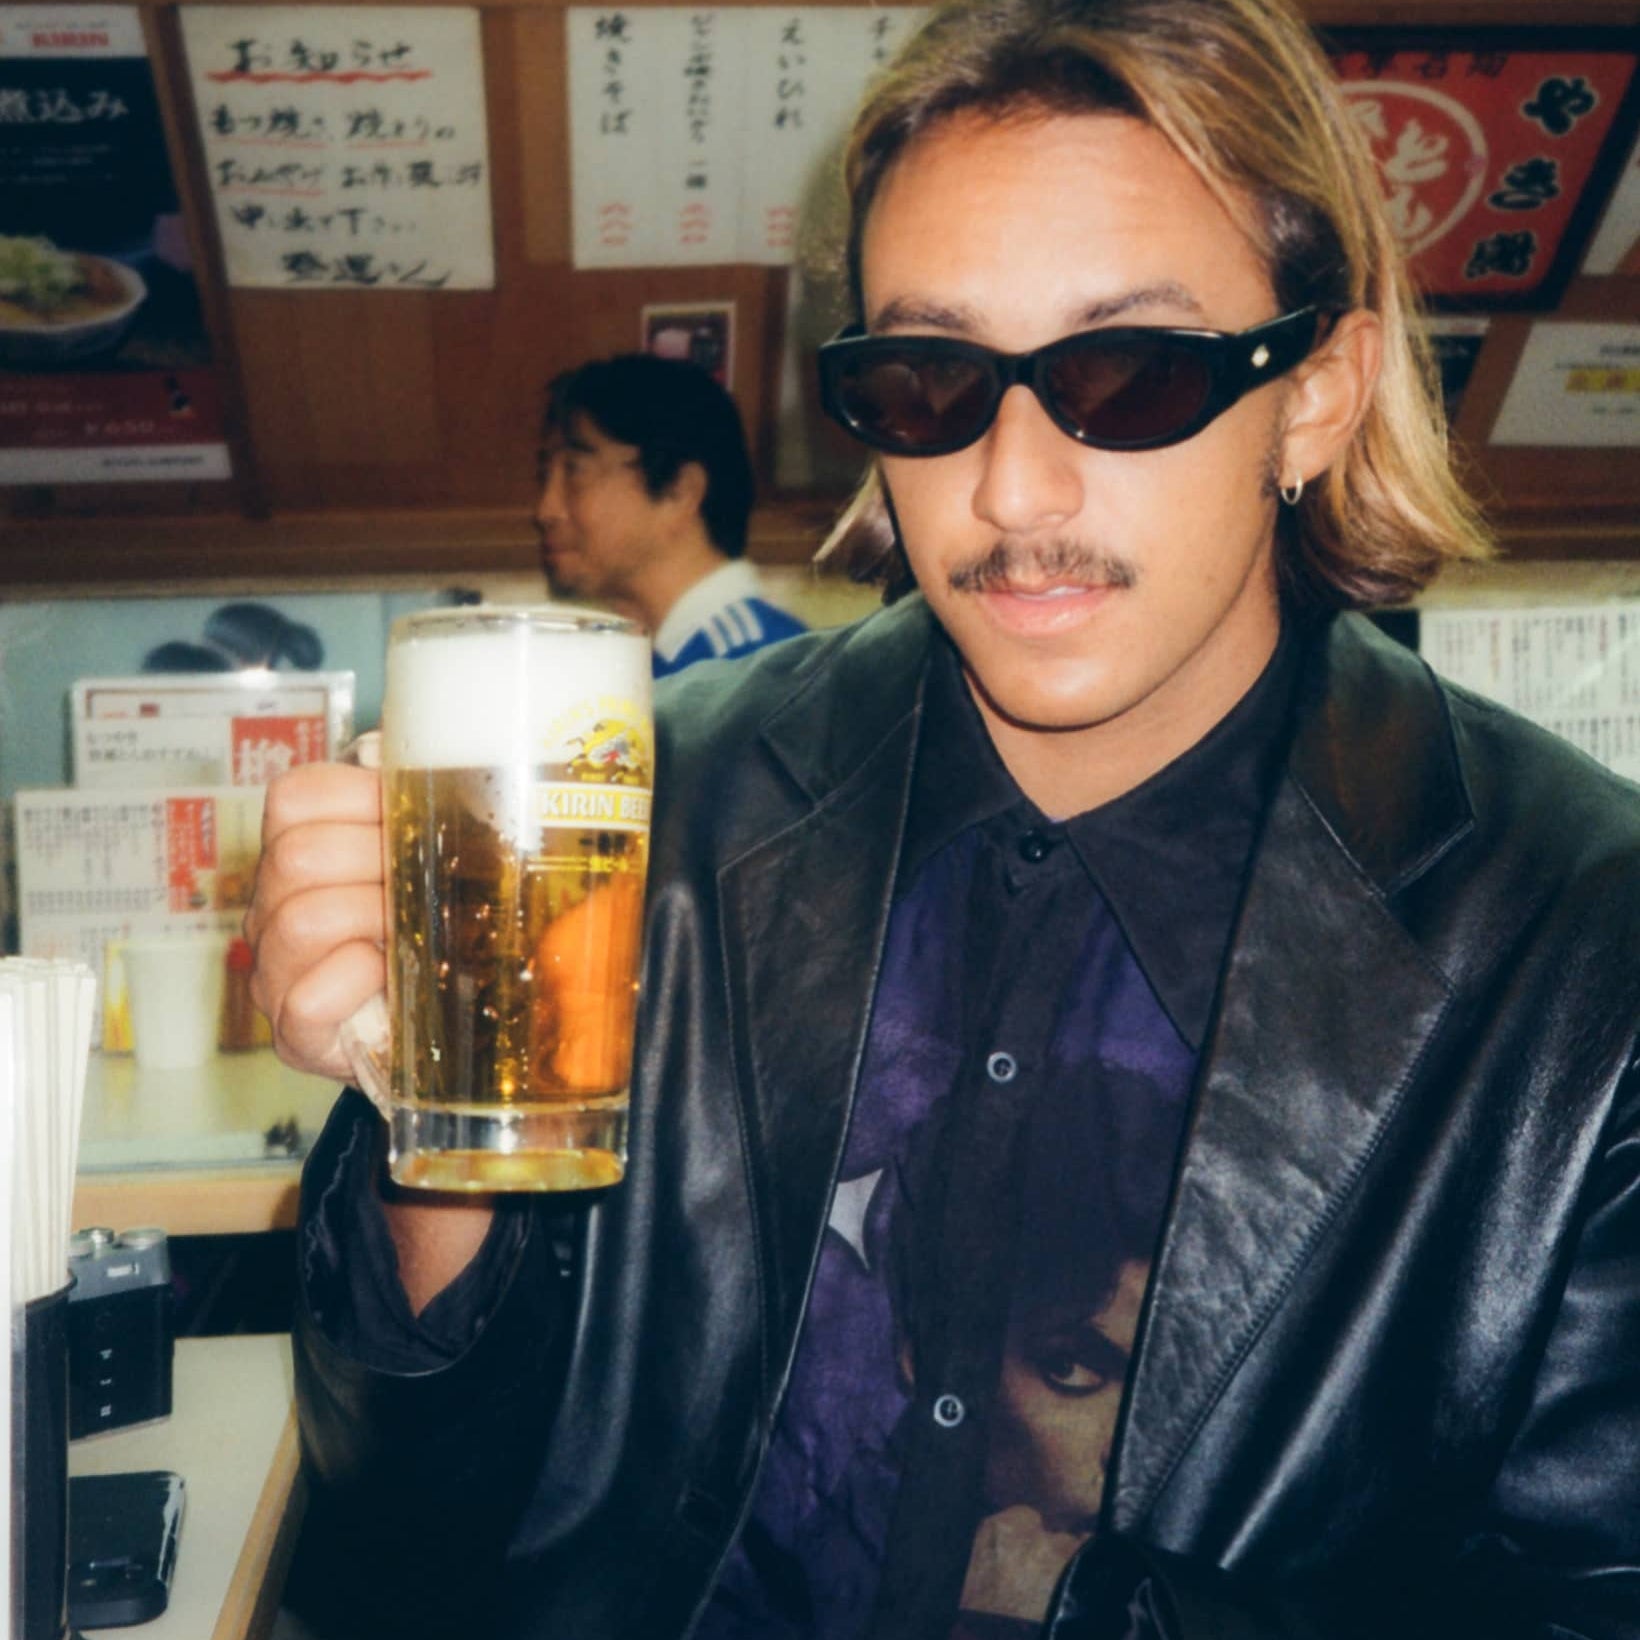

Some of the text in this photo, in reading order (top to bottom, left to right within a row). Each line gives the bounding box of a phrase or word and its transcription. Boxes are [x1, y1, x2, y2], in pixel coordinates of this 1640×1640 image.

[33, 31, 109, 47] KIRIN
[230, 38, 412, 72] お知らせ
[595, 13, 632, 136] 焼きそば
[774, 19, 806, 130] えいひれ
[543, 792, 650, 820] KIRIN BEE
